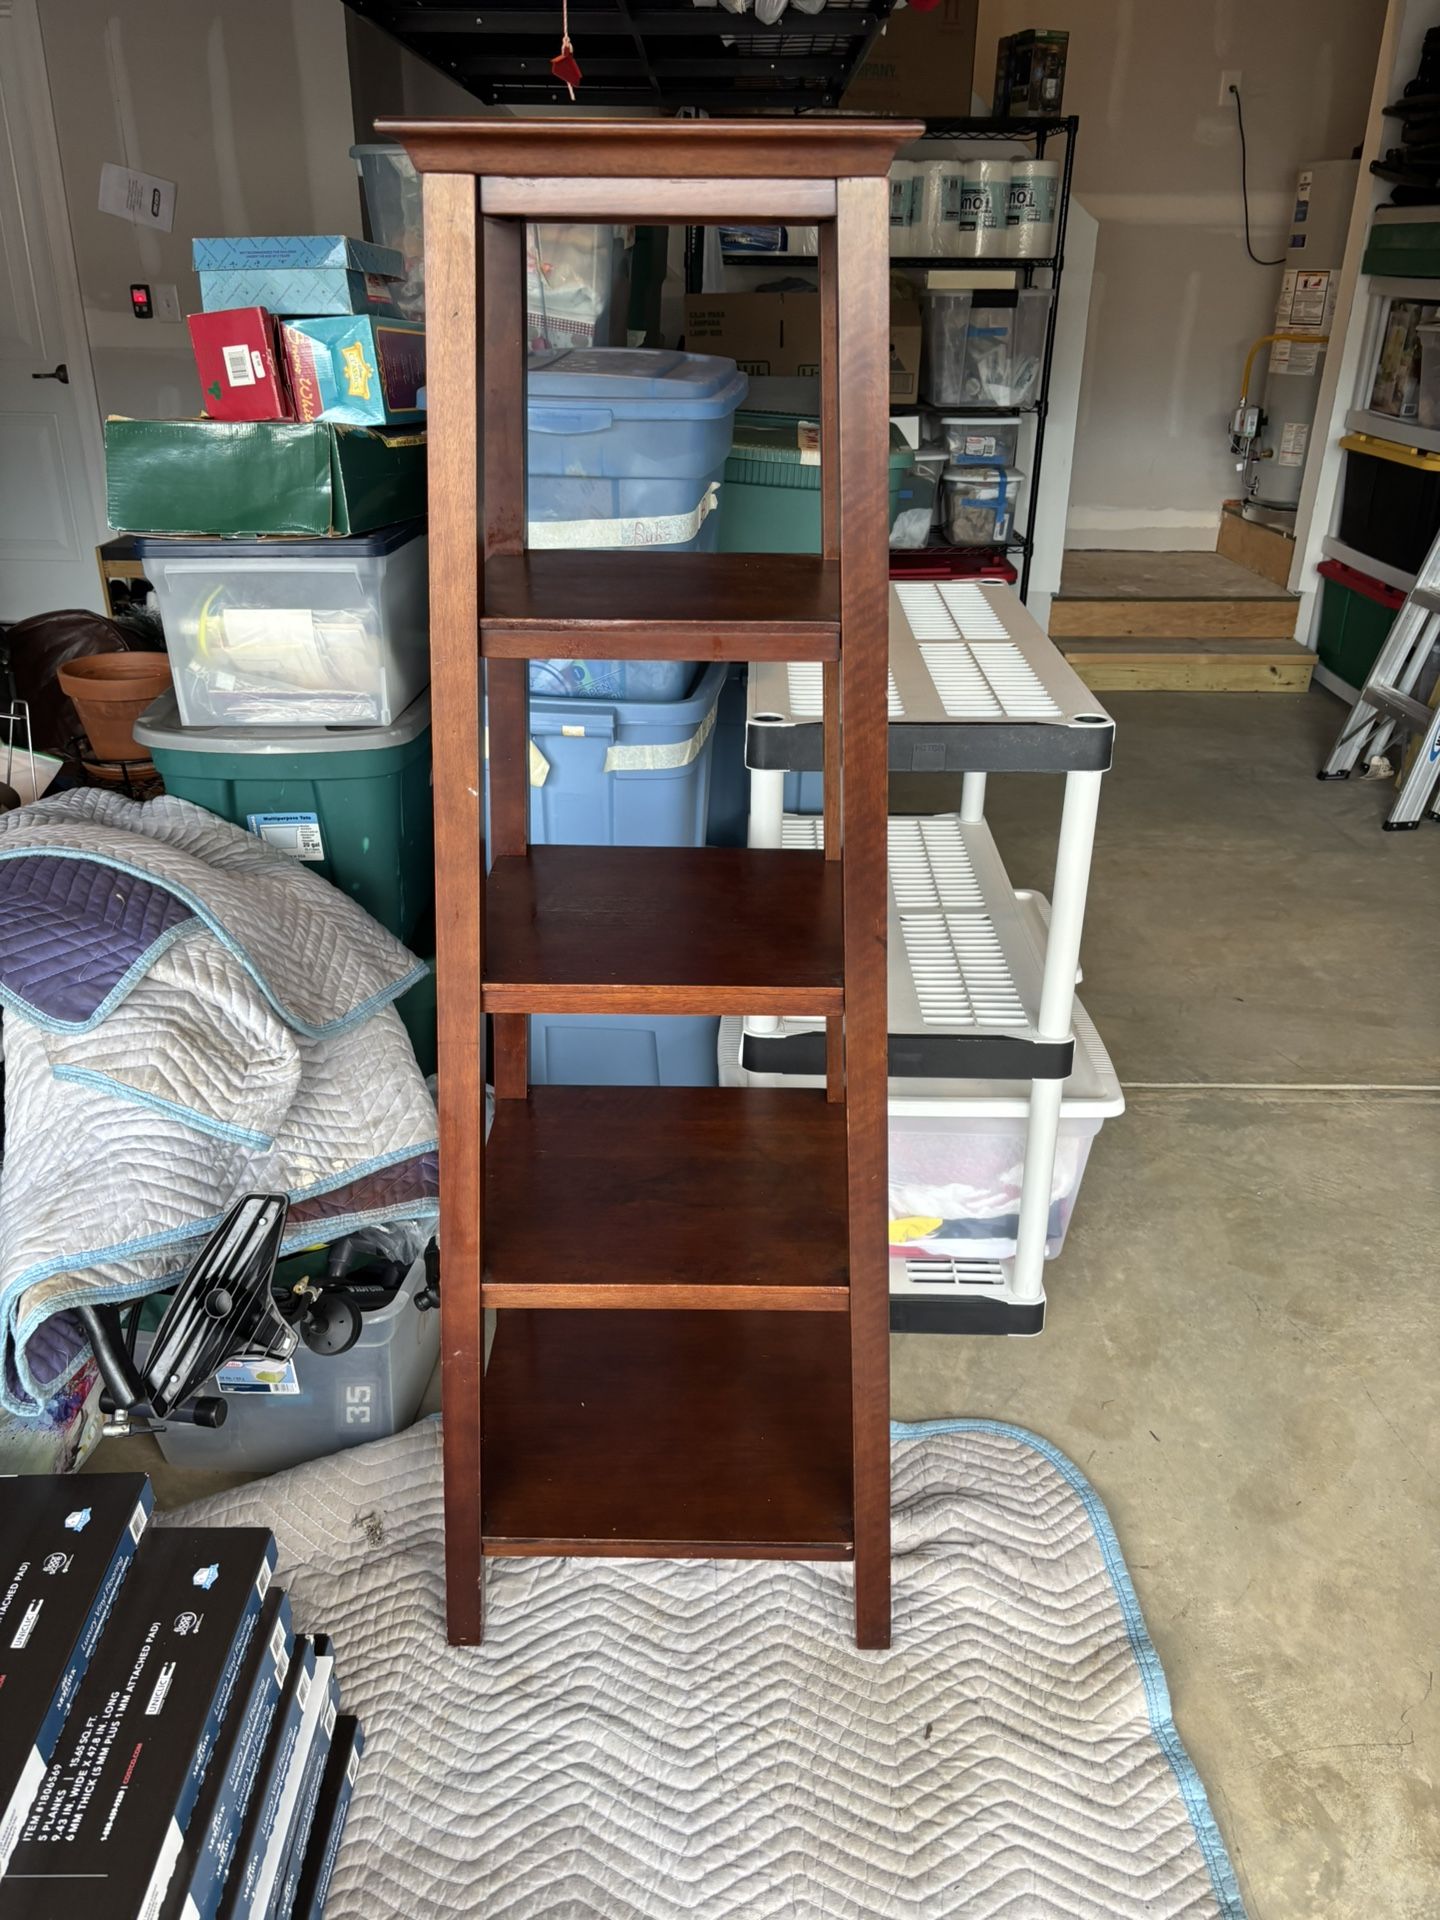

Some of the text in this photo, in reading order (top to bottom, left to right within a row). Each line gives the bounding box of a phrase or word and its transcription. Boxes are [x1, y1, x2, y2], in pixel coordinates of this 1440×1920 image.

[858, 64, 896, 80] PANY
[347, 1384, 371, 1424] 35
[15, 1561, 31, 1582] PAD)
[95, 1591, 107, 1618] Vinyl
[105, 1556, 124, 1593] Flooring
[14, 1614, 34, 1647] UNICLIC
[145, 1622, 161, 1643] PAD)
[126, 1645, 150, 1692] ATTACHED
[121, 1694, 131, 1711] MM
[148, 1677, 167, 1713] UNICLIC
[104, 1721, 120, 1744] PLUS
[51, 1819, 67, 1841] 9.43
[62, 1800, 75, 1815] IN.
[73, 1770, 86, 1797] WIDE
[87, 1738, 101, 1758] 47.8
[96, 1721, 107, 1734] IN.
[102, 1691, 120, 1719] LONG
[93, 1766, 102, 1776] (5
[97, 1746, 109, 1766] MM
[123, 1743, 143, 1785] COSTCO.COM
[23, 1764, 62, 1841] ITEM #1806569
[42, 1790, 66, 1831] PLANKS
[69, 1746, 84, 1767] 15.65
[77, 1778, 98, 1810] THICK
[69, 1813, 83, 1833] MM
